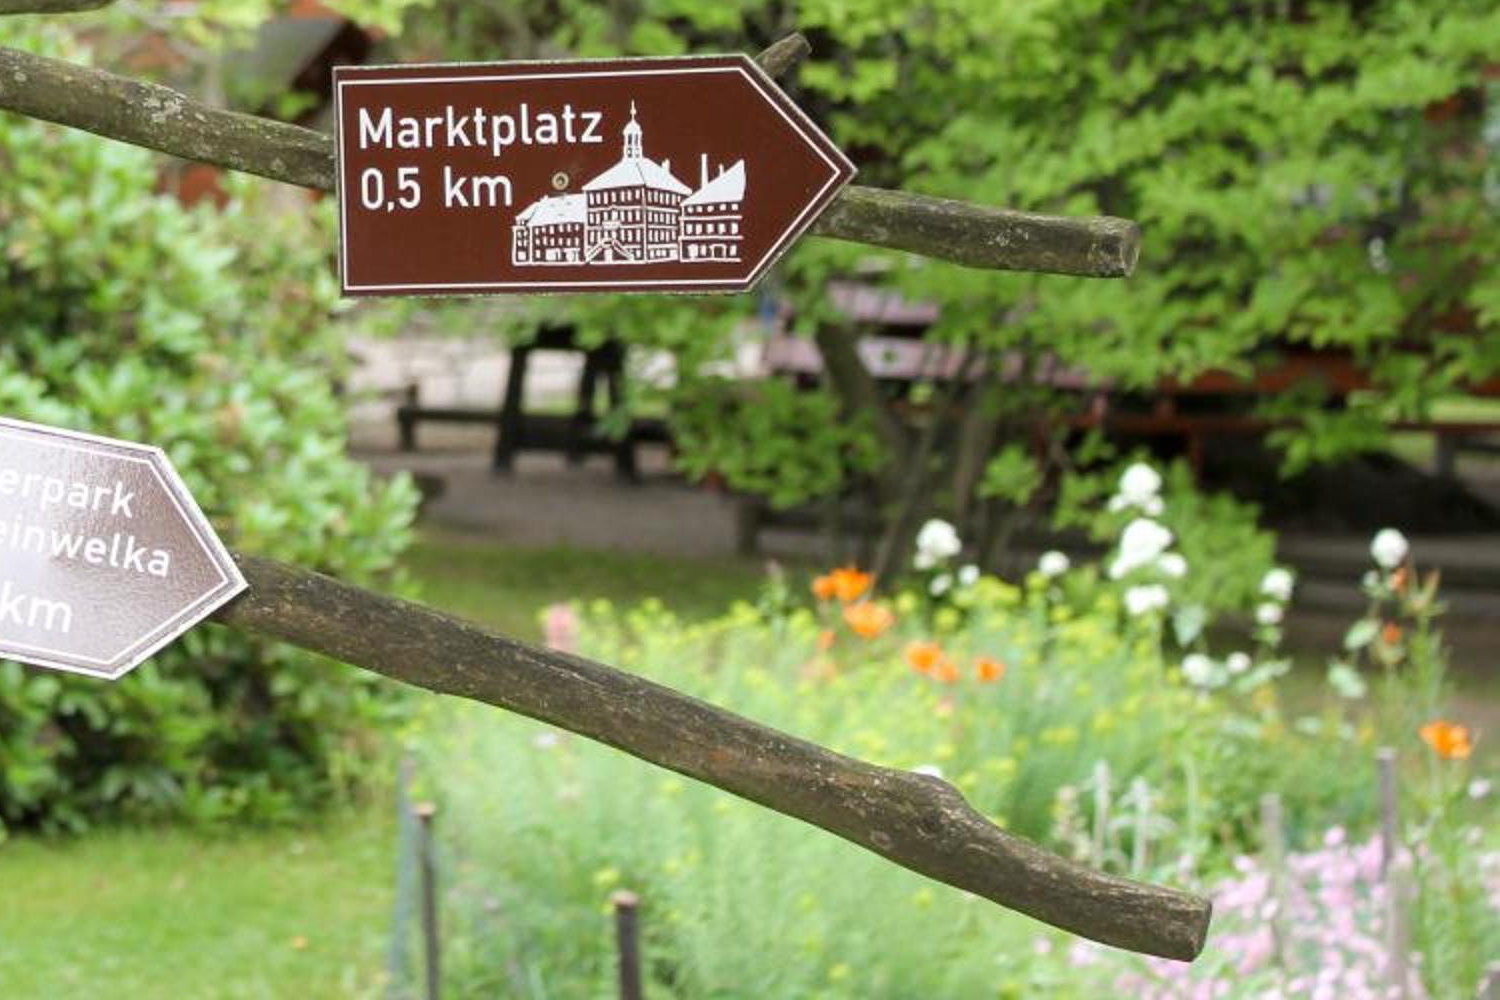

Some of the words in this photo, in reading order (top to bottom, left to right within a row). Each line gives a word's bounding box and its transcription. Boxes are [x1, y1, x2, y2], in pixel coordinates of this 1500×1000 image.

[358, 104, 604, 157] Marktplatz
[360, 167, 421, 212] 0,5
[444, 166, 512, 207] km
